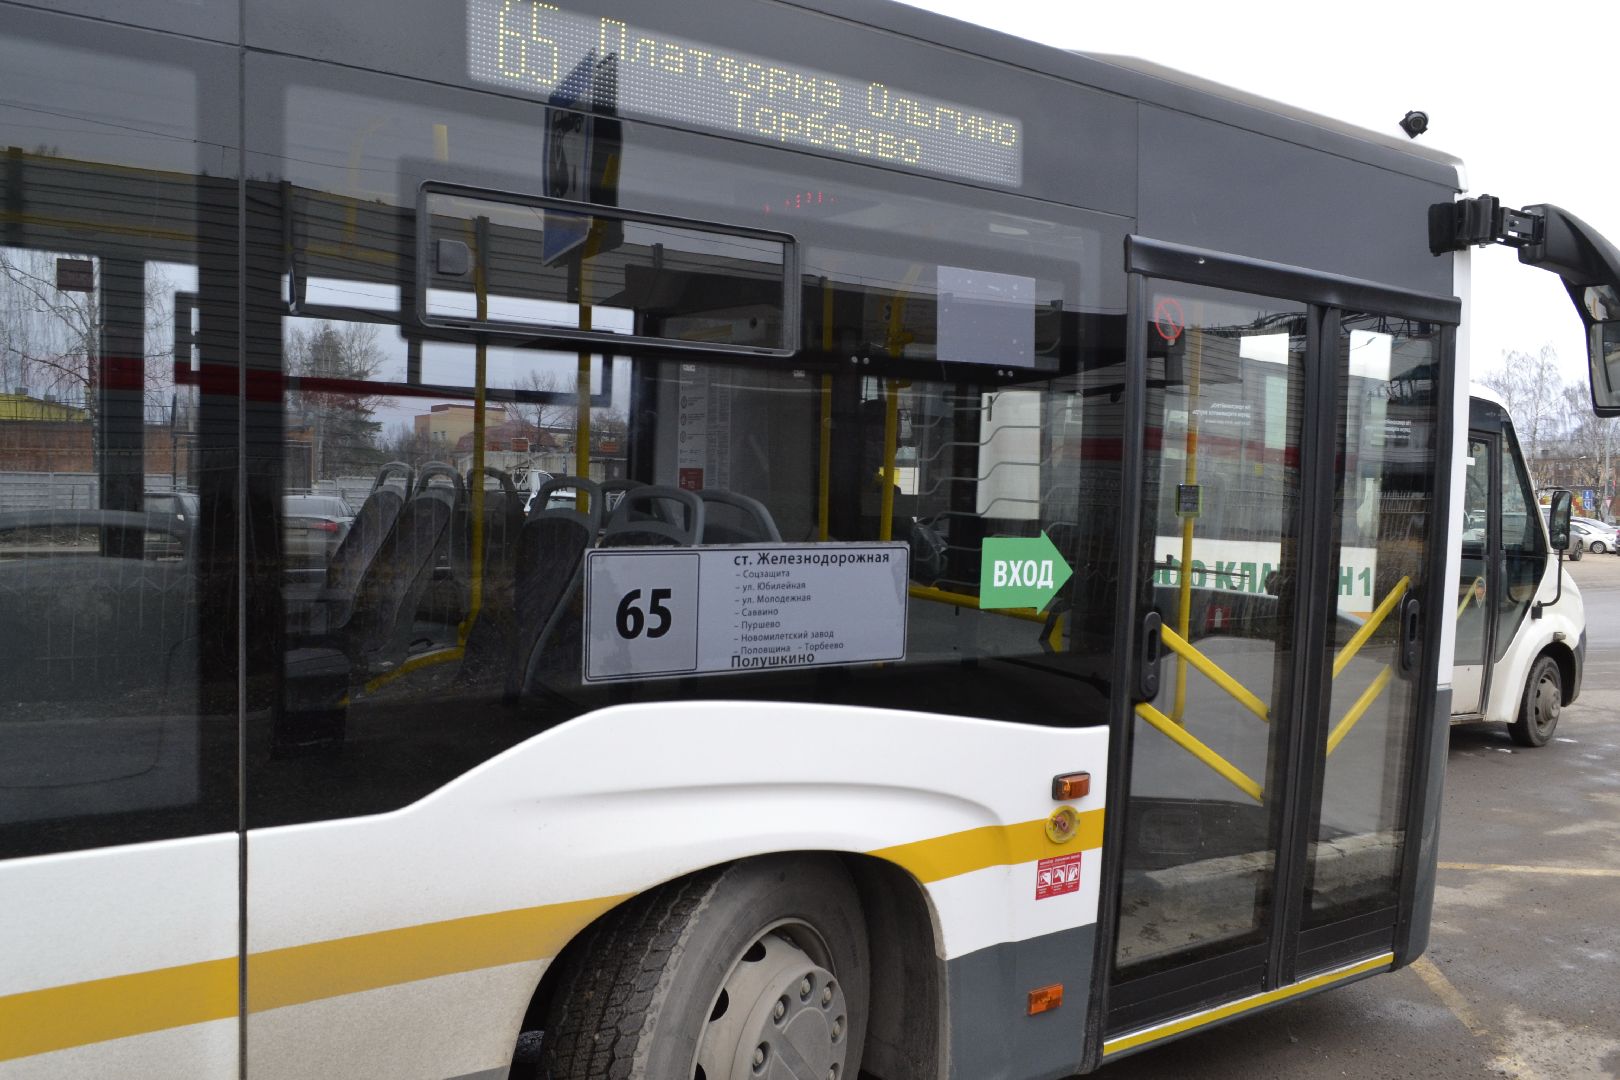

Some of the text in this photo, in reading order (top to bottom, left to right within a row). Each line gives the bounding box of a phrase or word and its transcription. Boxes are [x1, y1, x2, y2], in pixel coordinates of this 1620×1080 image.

[499, 0, 558, 86] 65
[600, 17, 1017, 146] Платформа Ольгино
[729, 90, 921, 163] Торбеево
[733, 552, 890, 567] ст. Железнодорожная
[742, 569, 790, 579] Соцзащита
[993, 559, 1054, 590] ВХОД
[742, 582, 806, 593] ул. Юбилейная
[742, 594, 811, 606] ул. Молодежная
[615, 588, 672, 640] 65
[741, 608, 779, 617] Саввино
[741, 620, 781, 631] Пуршево
[741, 631, 834, 642] Новомилетский завод
[804, 642, 844, 651] Торбеево
[730, 653, 815, 668] Полушкино
